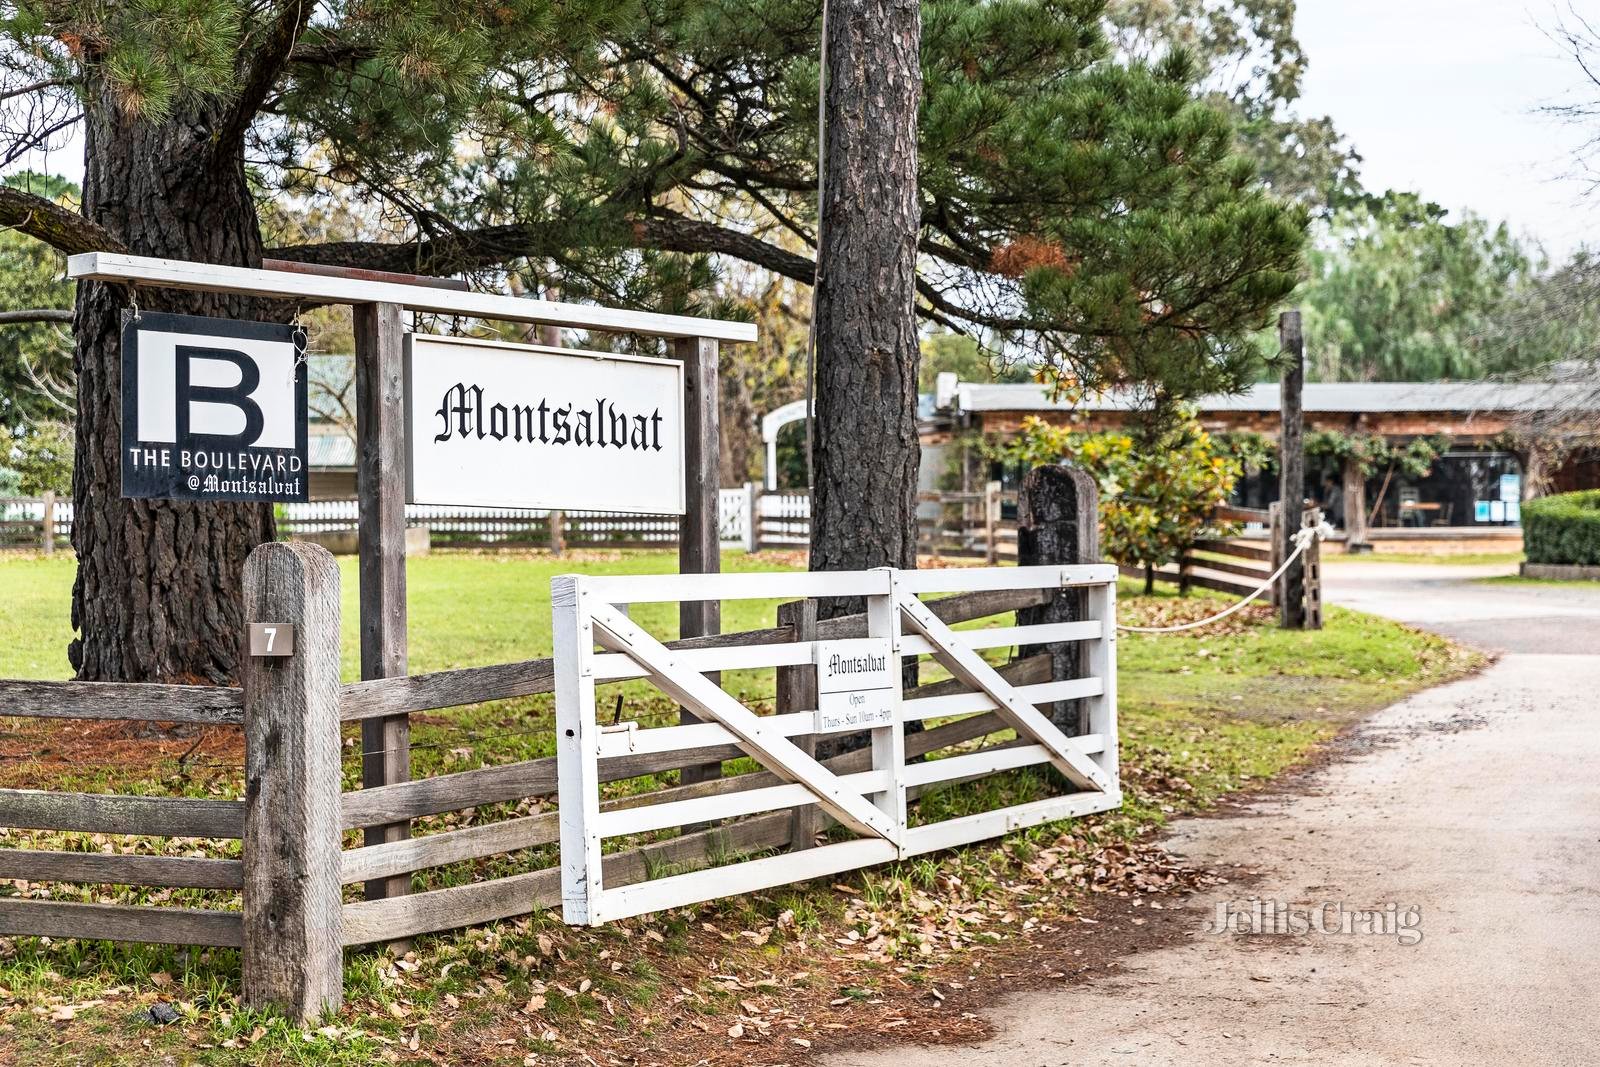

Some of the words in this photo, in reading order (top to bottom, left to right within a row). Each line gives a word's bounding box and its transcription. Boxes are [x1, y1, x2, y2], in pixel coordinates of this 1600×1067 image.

[175, 344, 264, 447] B
[434, 382, 663, 452] Montsalvat
[130, 448, 171, 467] THE
[181, 450, 302, 473] BOULEVARD
[264, 627, 277, 652] 7
[828, 653, 886, 677] Montsalvat
[849, 693, 866, 708] Open
[823, 715, 841, 729] Thurs
[845, 713, 858, 725] Sun
